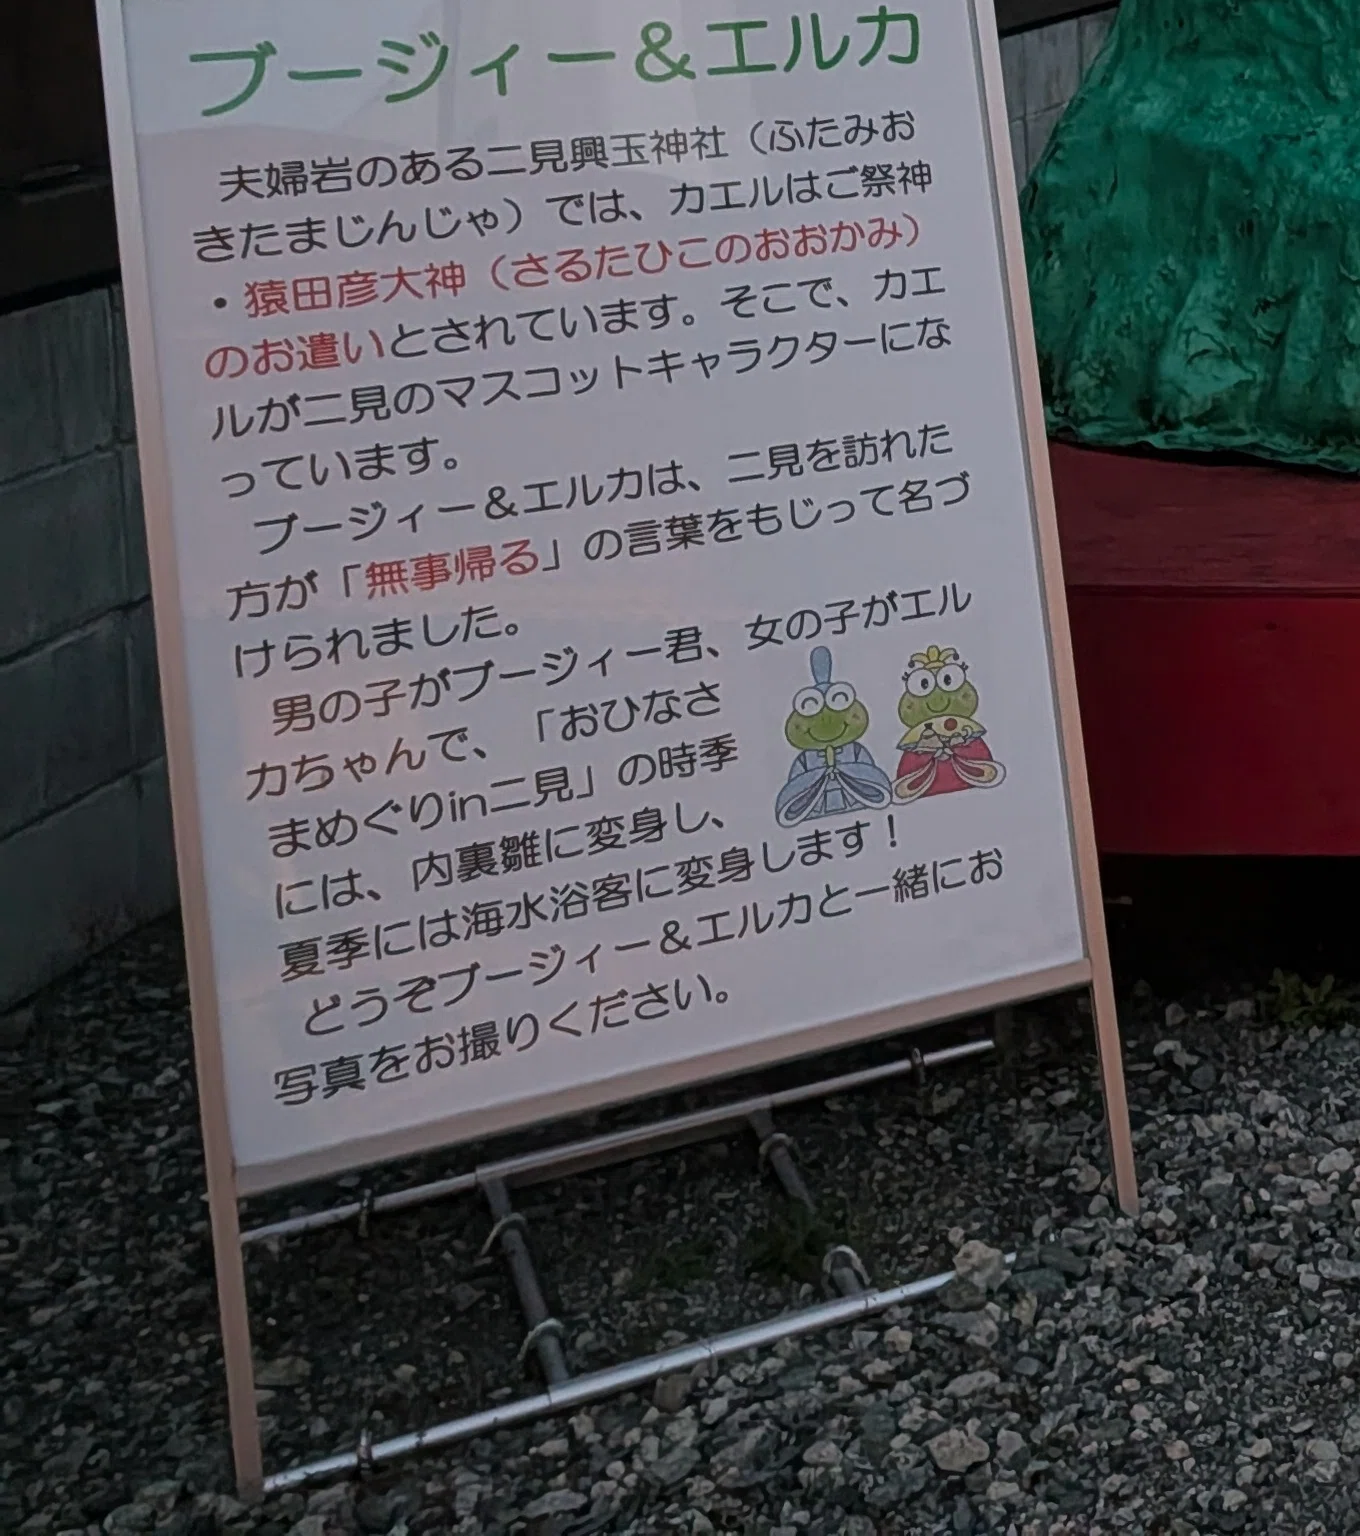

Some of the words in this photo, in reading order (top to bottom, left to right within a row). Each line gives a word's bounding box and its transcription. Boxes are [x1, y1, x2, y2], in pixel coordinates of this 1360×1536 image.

[189, 5, 920, 117] ブージィー＆エルカ
[221, 436, 458, 498] っています。
[235, 605, 519, 678] けられました。
[273, 973, 729, 1106] 写真をお撮りください。
